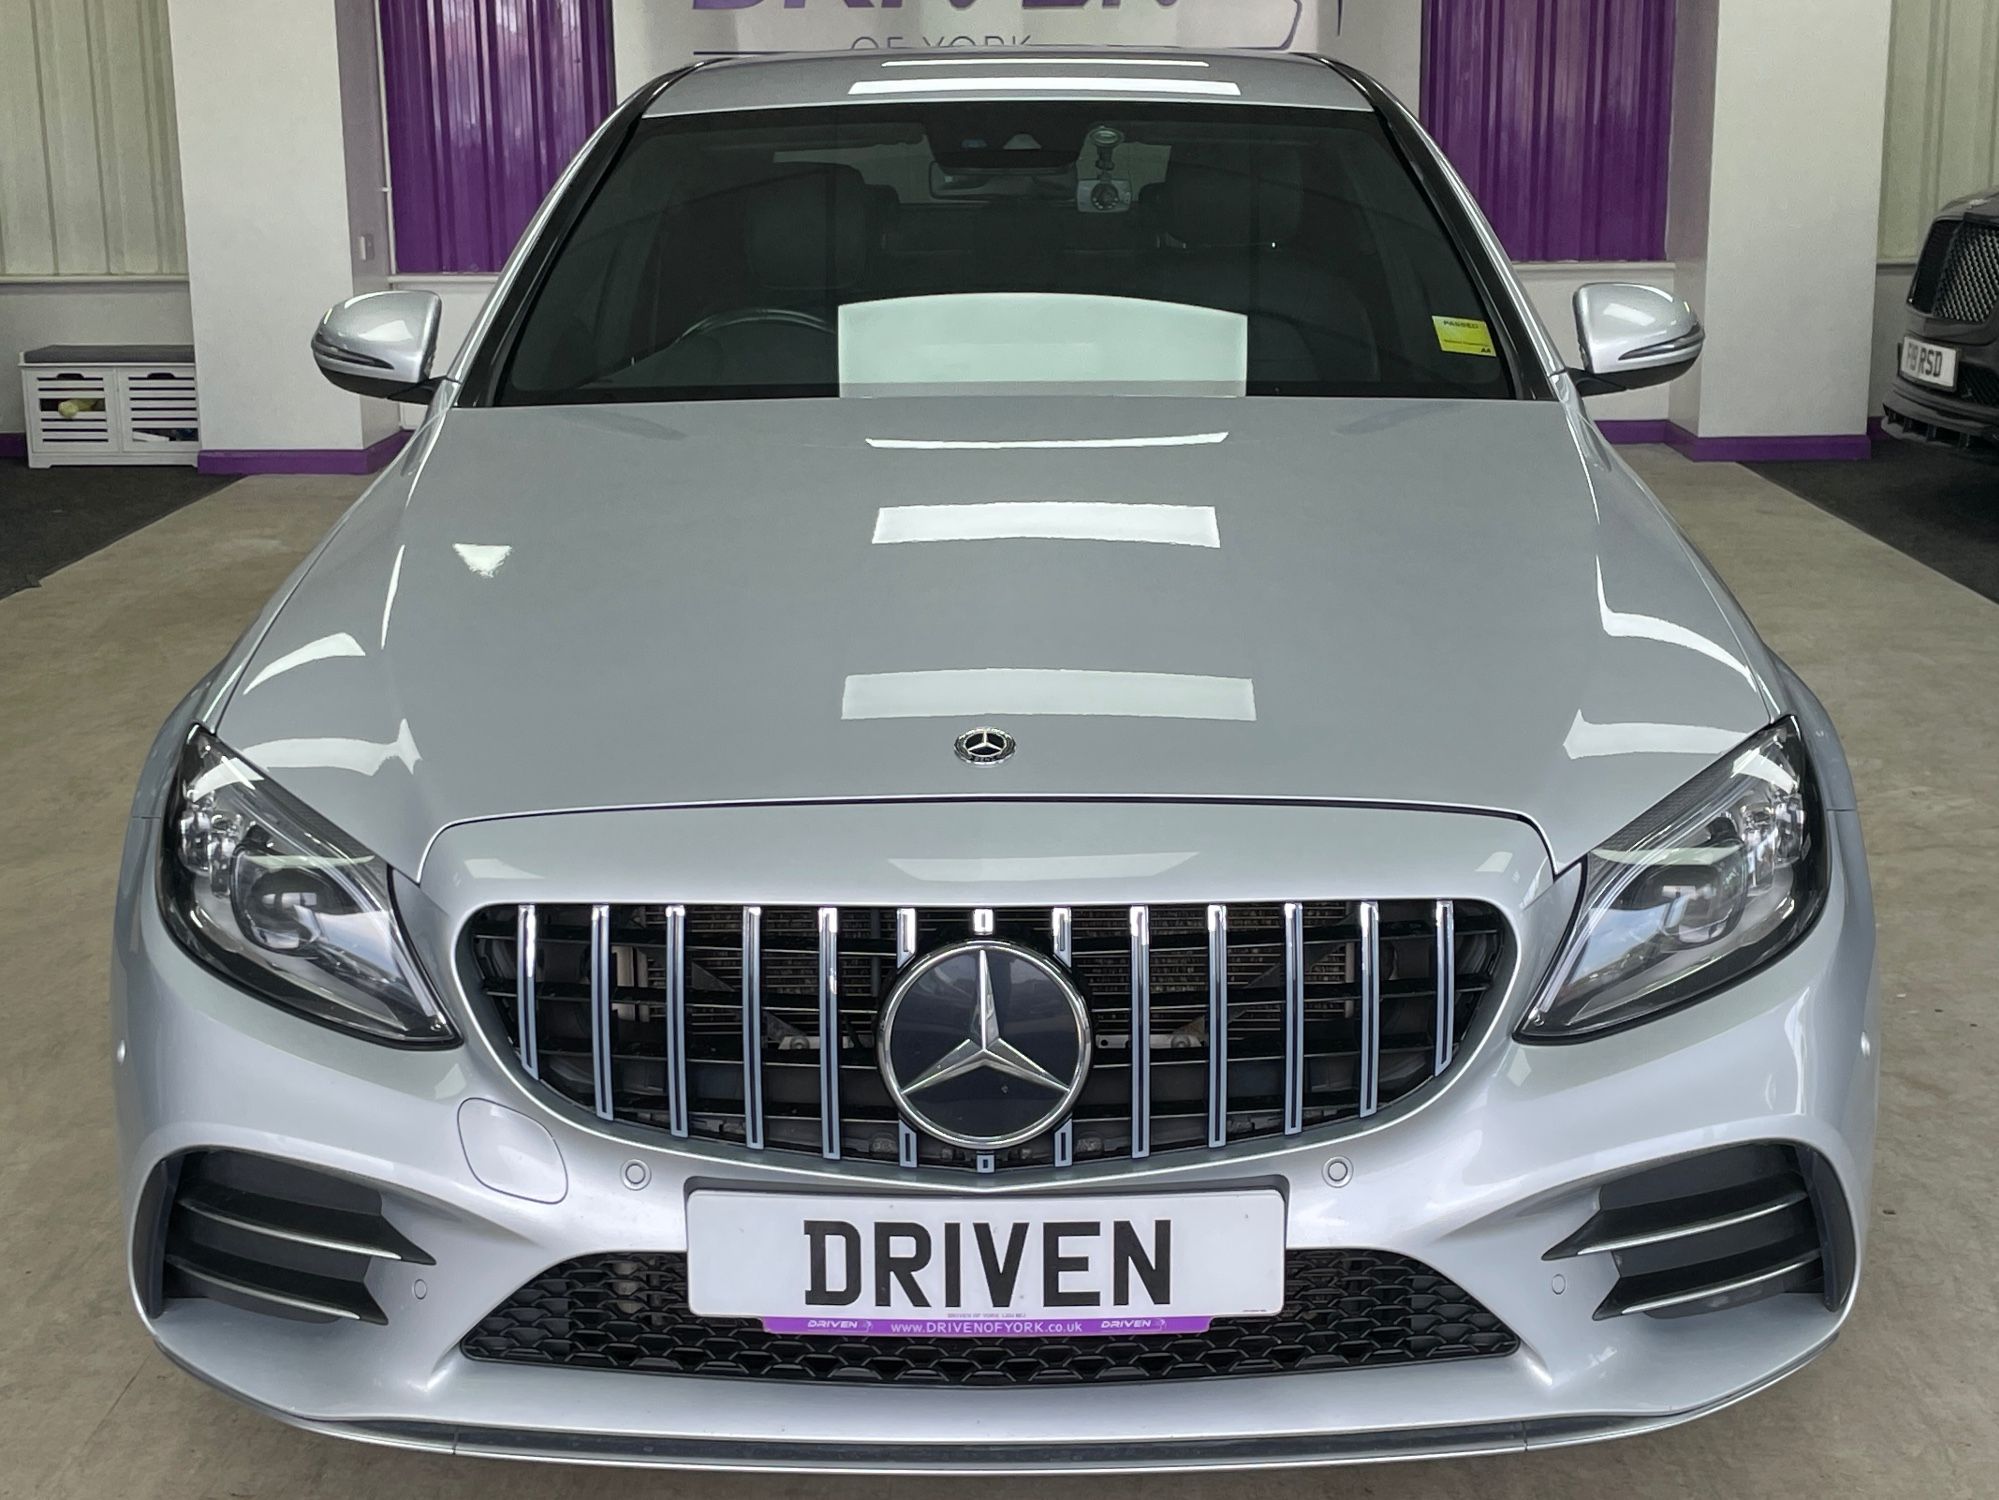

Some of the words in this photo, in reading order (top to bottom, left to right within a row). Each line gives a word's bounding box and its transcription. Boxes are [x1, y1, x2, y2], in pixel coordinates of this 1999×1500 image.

[803, 1219, 1171, 1308] DRIVEN
[807, 1319, 858, 1329] DRIVEN
[890, 1321, 1082, 1334] www.DRIVENOFYORK.co.uk
[1100, 1318, 1152, 1329] DRIVEN
